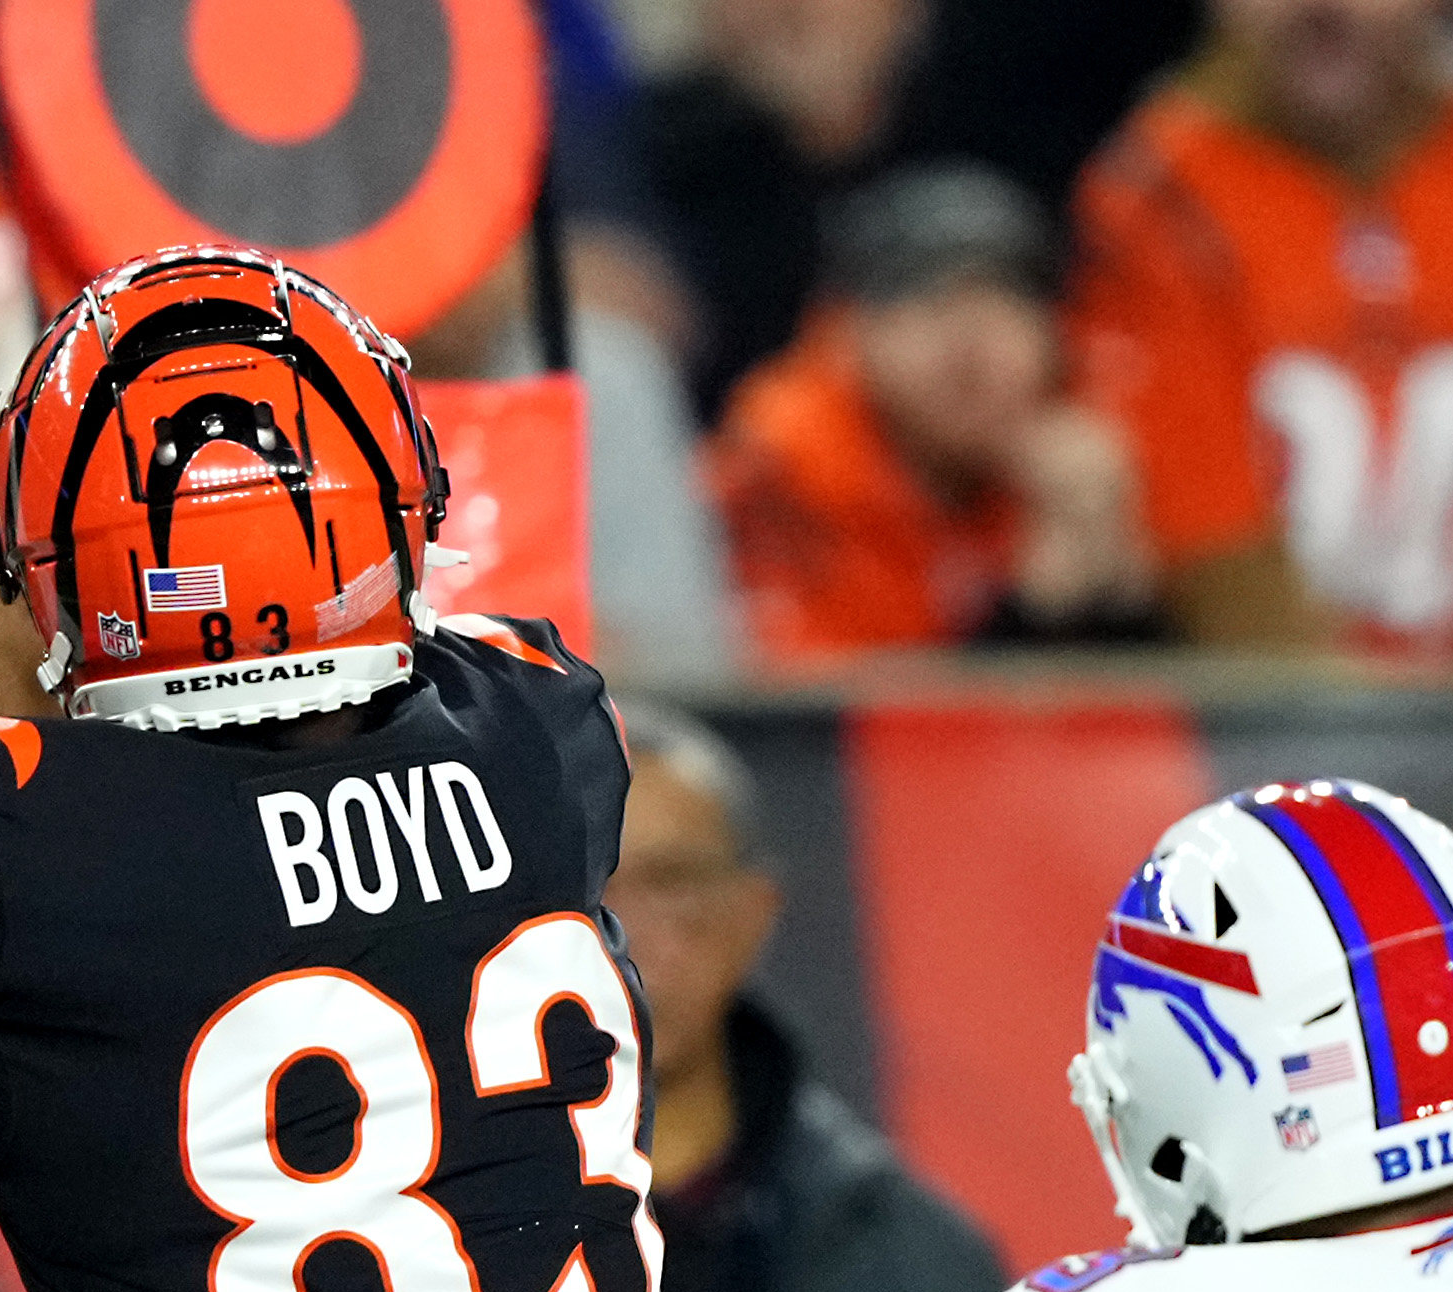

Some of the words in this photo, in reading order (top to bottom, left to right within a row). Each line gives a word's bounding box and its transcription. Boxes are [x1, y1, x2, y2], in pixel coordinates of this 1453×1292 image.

[200, 603, 290, 662] 83
[164, 659, 337, 696] BENGALS
[257, 761, 513, 927] BOYD
